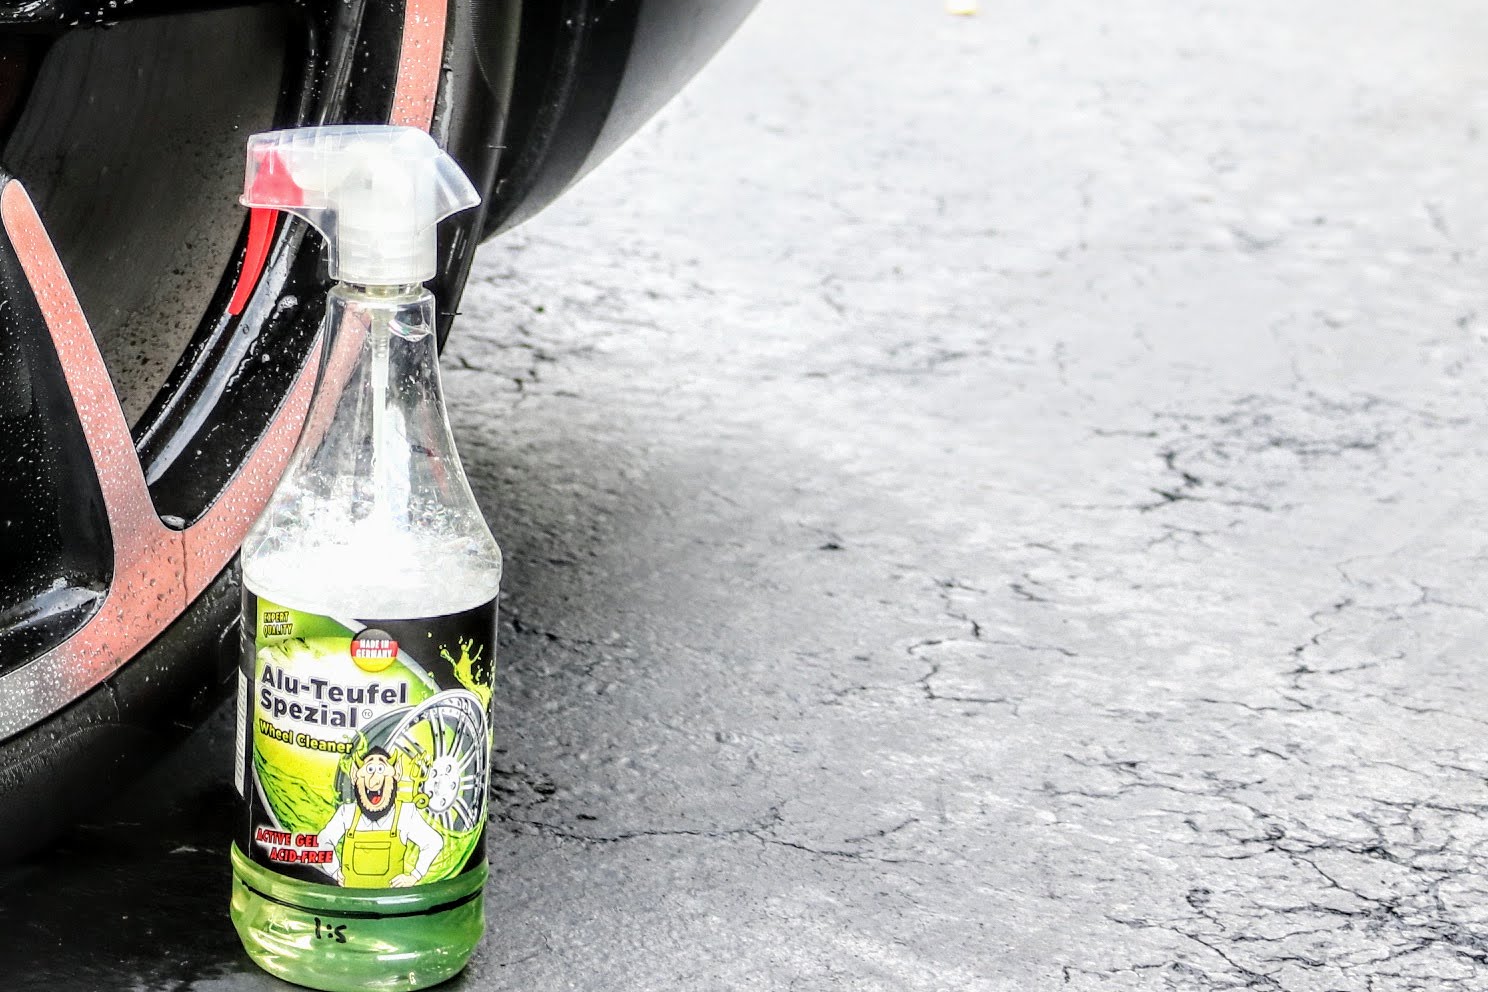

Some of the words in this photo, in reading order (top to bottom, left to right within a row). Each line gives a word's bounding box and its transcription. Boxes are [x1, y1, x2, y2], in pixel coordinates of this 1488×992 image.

[263, 611, 289, 623] EXPERT
[263, 623, 293, 638] QUALITY
[359, 639, 379, 648] MADE
[380, 639, 390, 648] IN
[355, 648, 392, 658] GERMANY
[261, 664, 407, 704] Alu-Teufel
[260, 688, 358, 728] Spezial
[258, 719, 293, 744] Wheel
[296, 733, 354, 754] Cleaner
[255, 827, 292, 846] ACTIVE
[295, 834, 319, 847] GEL
[270, 847, 334, 863] ACID-FREE
